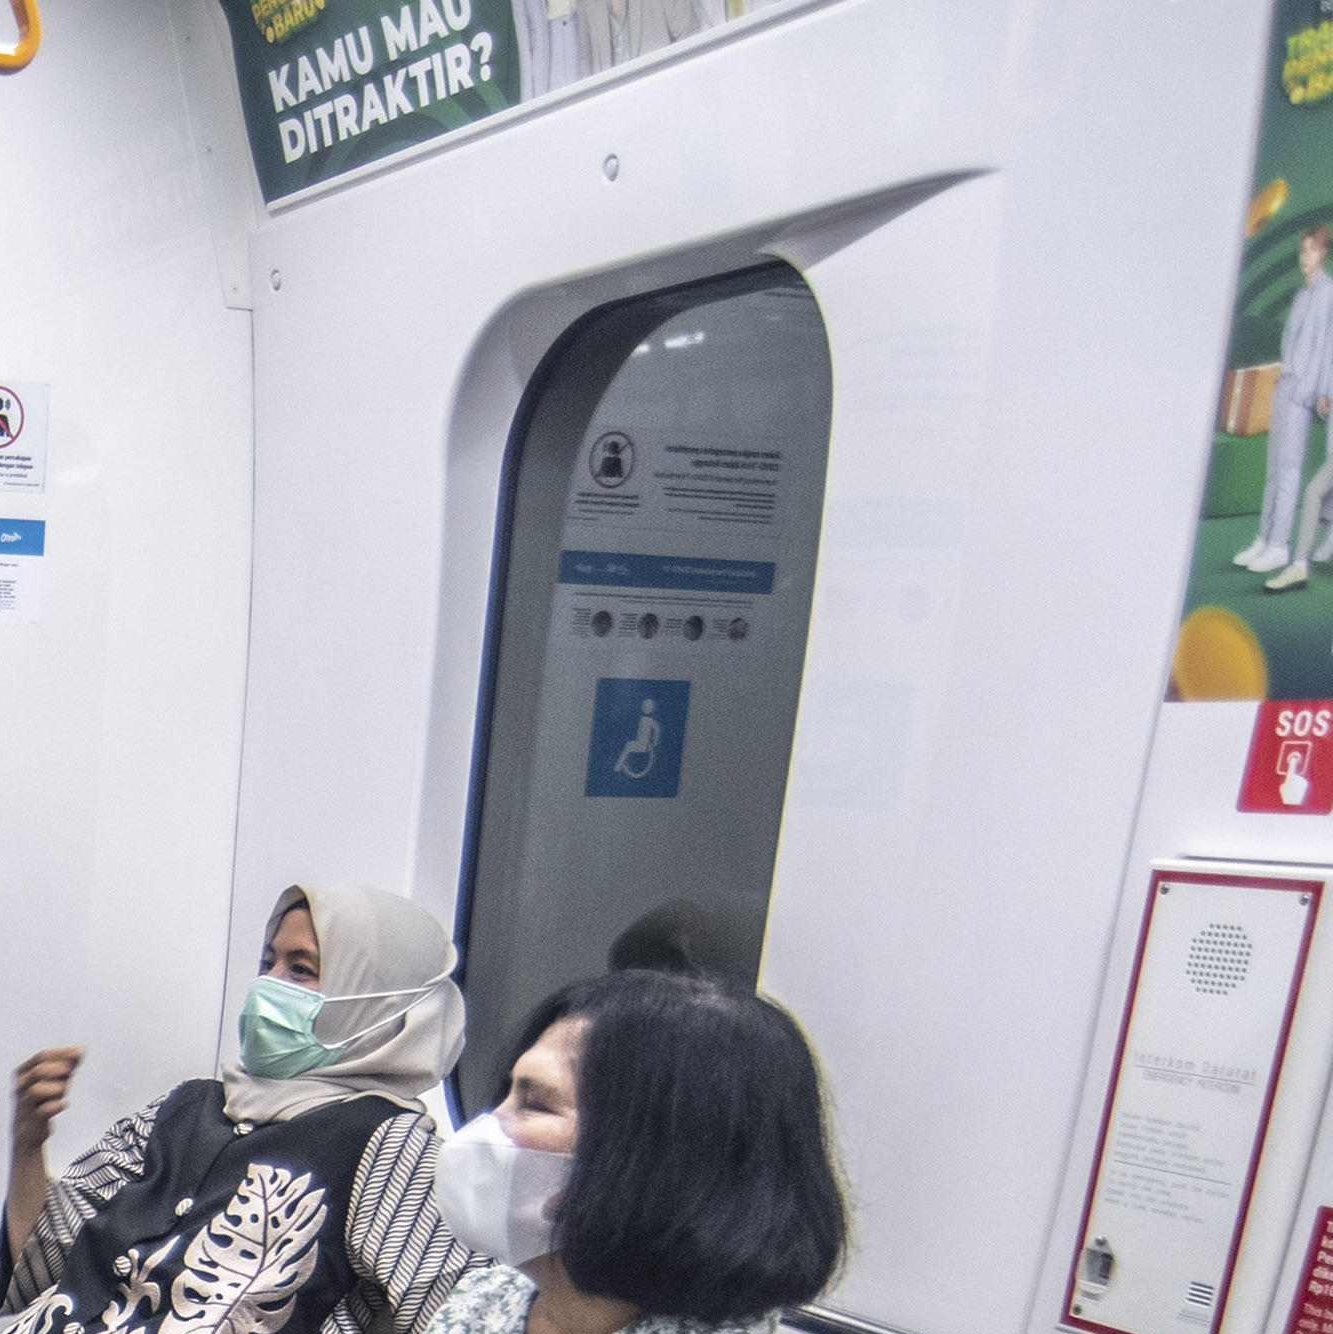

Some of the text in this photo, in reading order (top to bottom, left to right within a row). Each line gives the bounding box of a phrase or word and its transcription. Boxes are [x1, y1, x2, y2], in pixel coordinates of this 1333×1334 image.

[272, 0, 315, 39] BARU
[267, 0, 471, 113] KAMU MAU
[277, 31, 494, 164] DITRAKTIR?
[1276, 710, 1331, 737] SOS
[1133, 1053, 1257, 1081] Interkom Darurat
